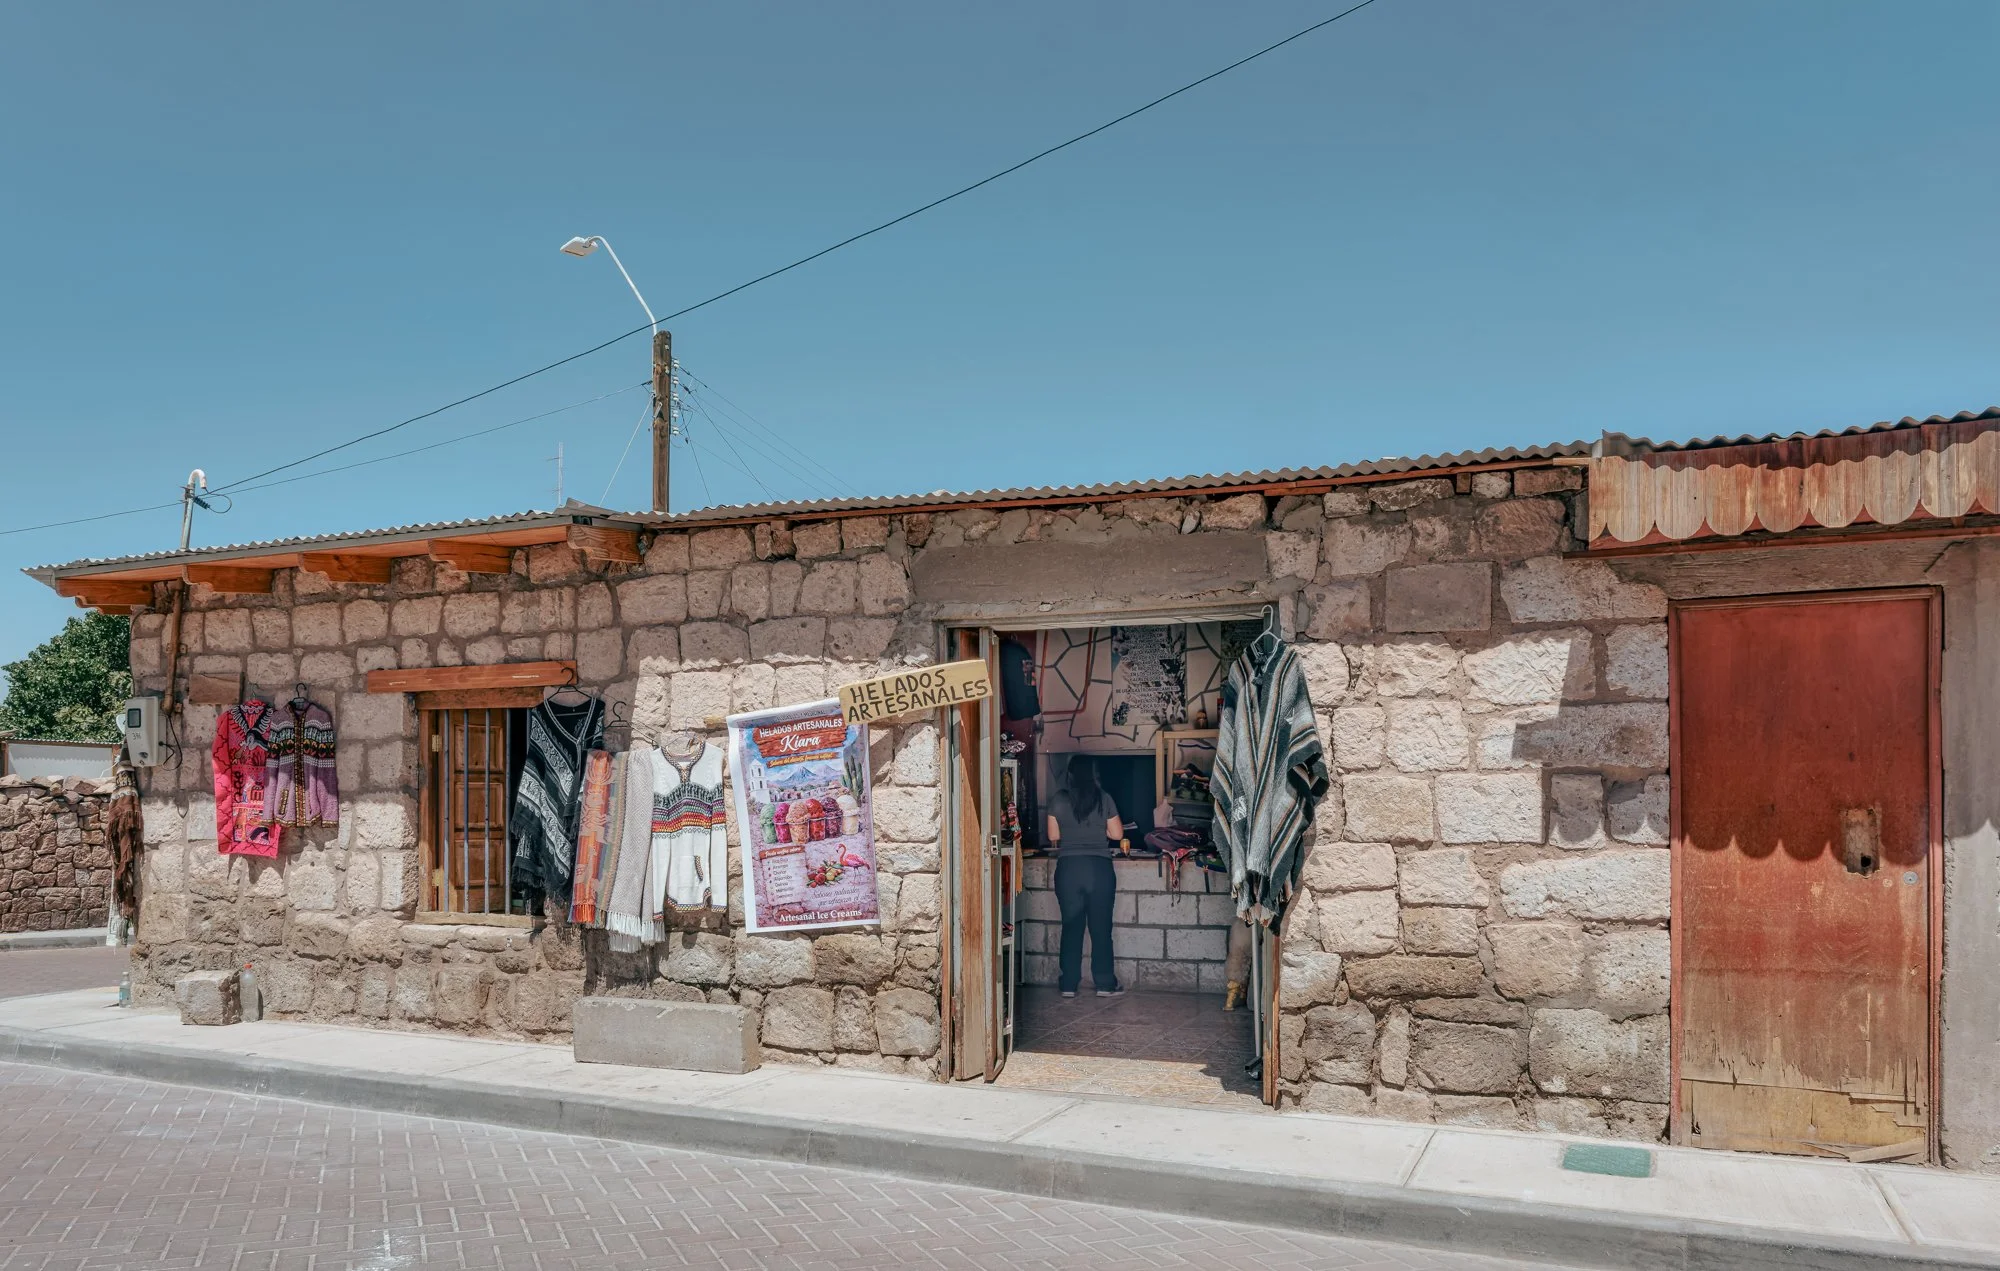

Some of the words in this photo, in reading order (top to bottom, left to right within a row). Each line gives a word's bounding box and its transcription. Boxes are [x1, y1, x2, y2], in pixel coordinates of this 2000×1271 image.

[849, 669, 946, 703] HELADOS
[848, 679, 989, 722] ARTESANALES
[759, 725, 792, 738] HELADOS
[792, 718, 843, 732] ARTESANALES
[780, 734, 821, 752] Kiara
[779, 911, 816, 922] Artesanal
[817, 911, 829, 919] Ice
[830, 908, 862, 919] Creams
